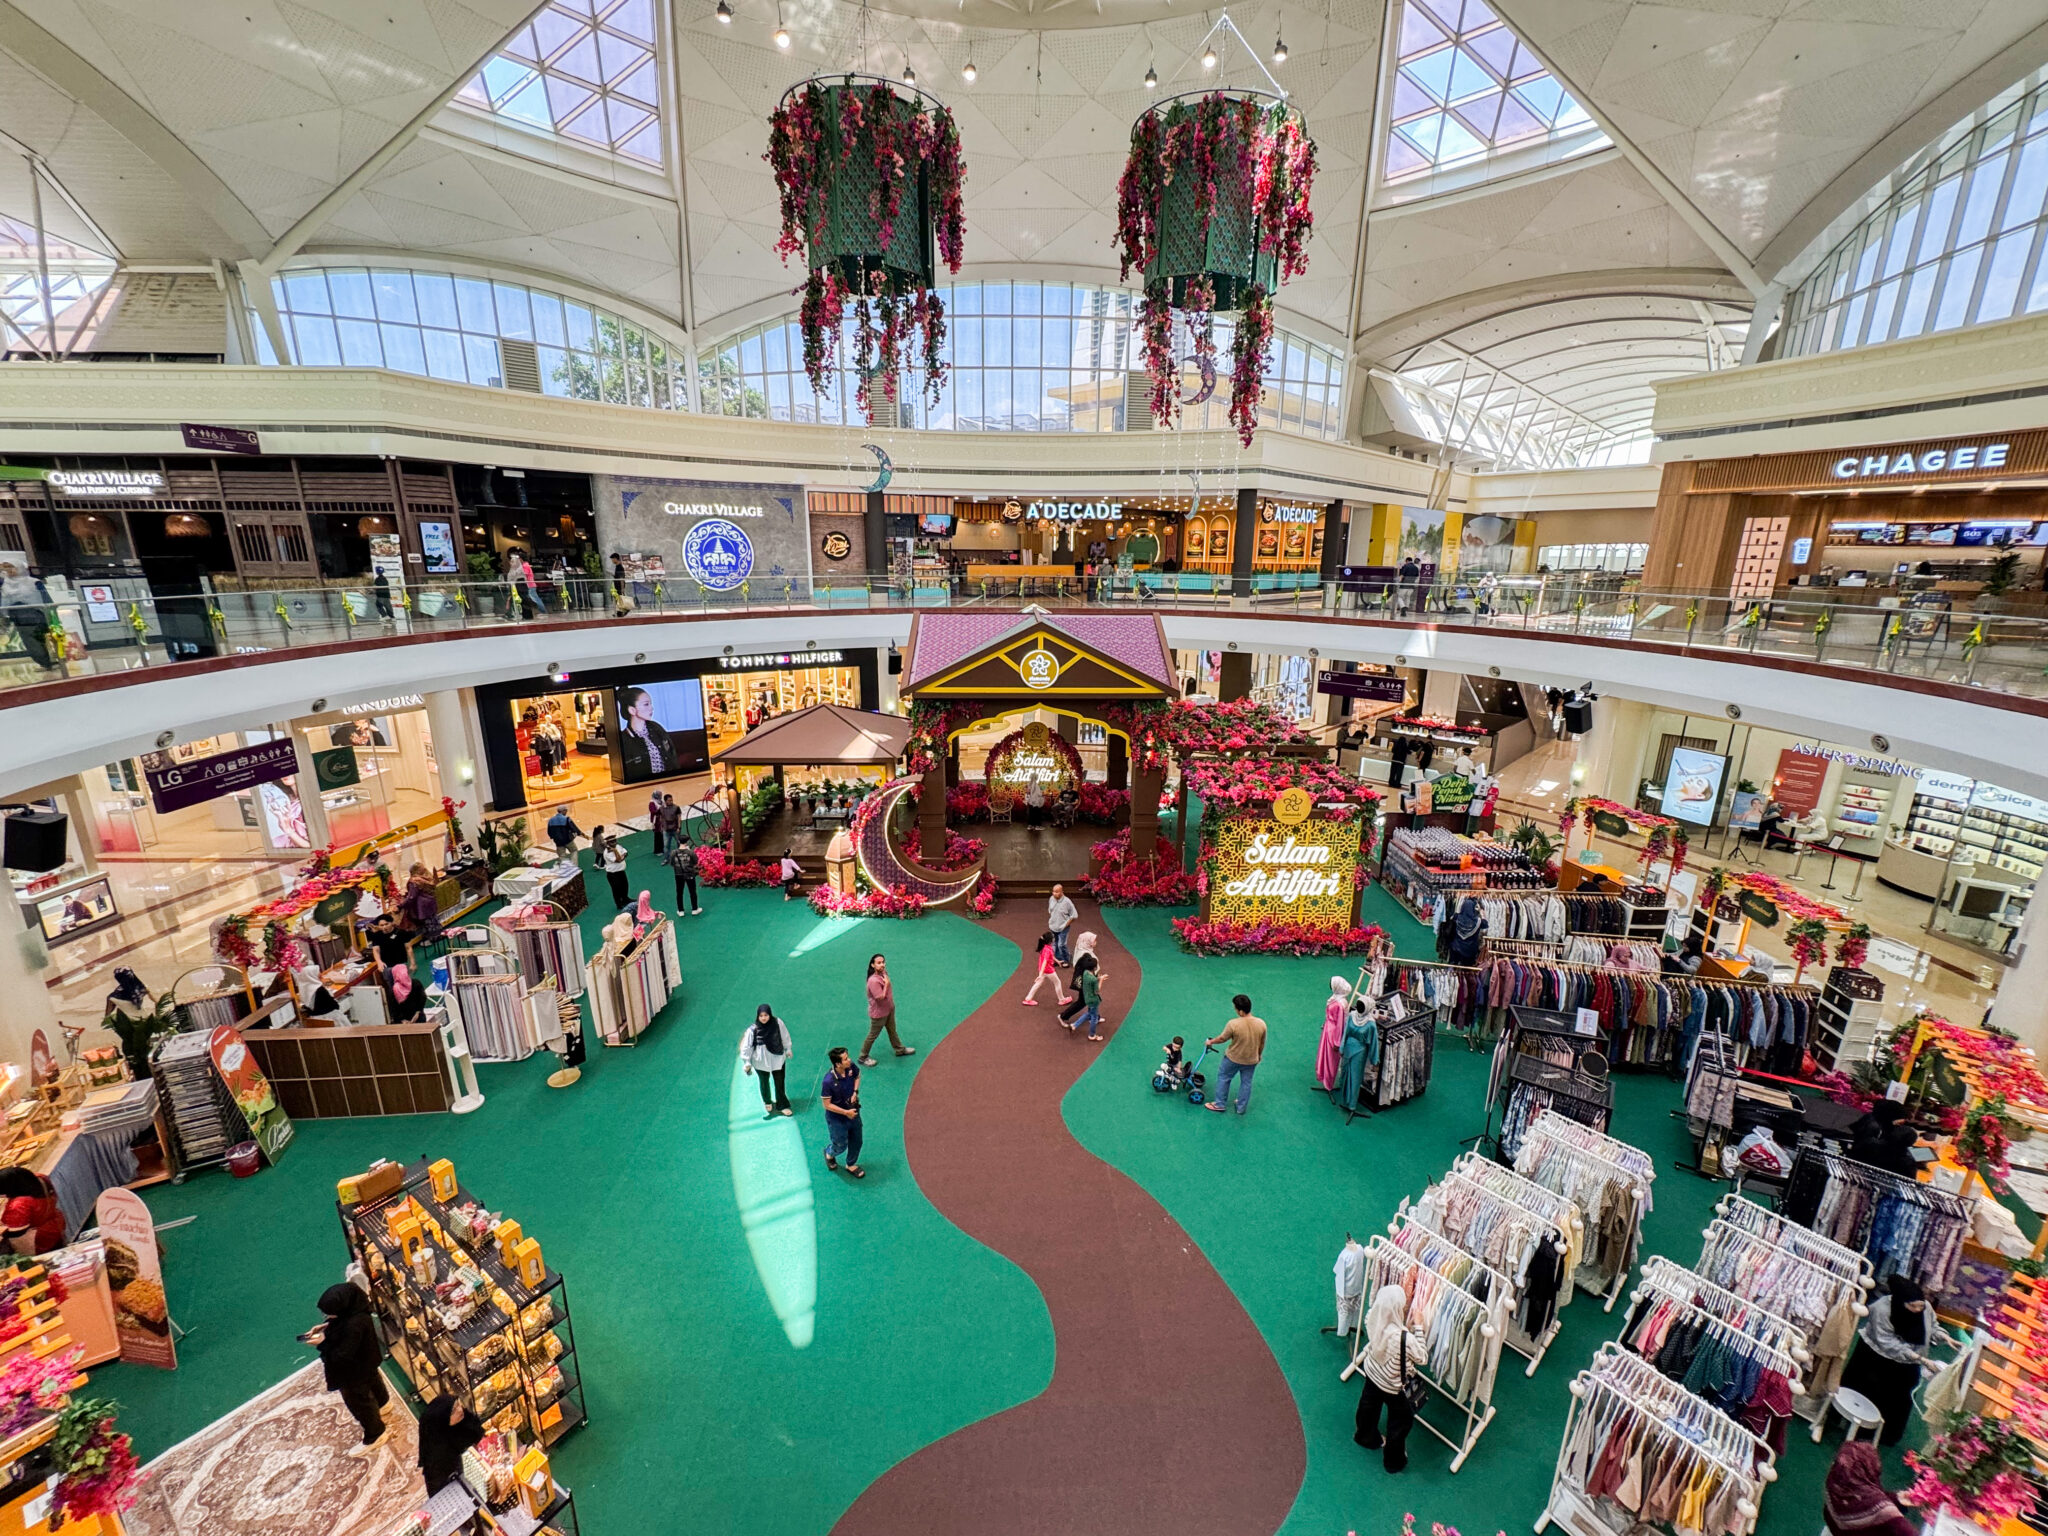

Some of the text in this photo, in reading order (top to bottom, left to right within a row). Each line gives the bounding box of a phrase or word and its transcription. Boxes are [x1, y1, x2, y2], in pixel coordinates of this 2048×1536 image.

[247, 433, 258, 444] G
[1835, 444, 2011, 478] CHAGEE
[48, 471, 162, 486] CHAKRI VILLAGE
[664, 502, 764, 517] CHAKRI VILLAGE
[720, 651, 844, 669] TOMMY HILFIGER
[1319, 672, 1332, 681] LG
[1013, 751, 1055, 767] Salam
[1792, 742, 1925, 780] ASTER SPRING
[157, 770, 183, 789] LG
[1245, 833, 1331, 864] Salam
[1225, 868, 1341, 904] Aidilfitri
